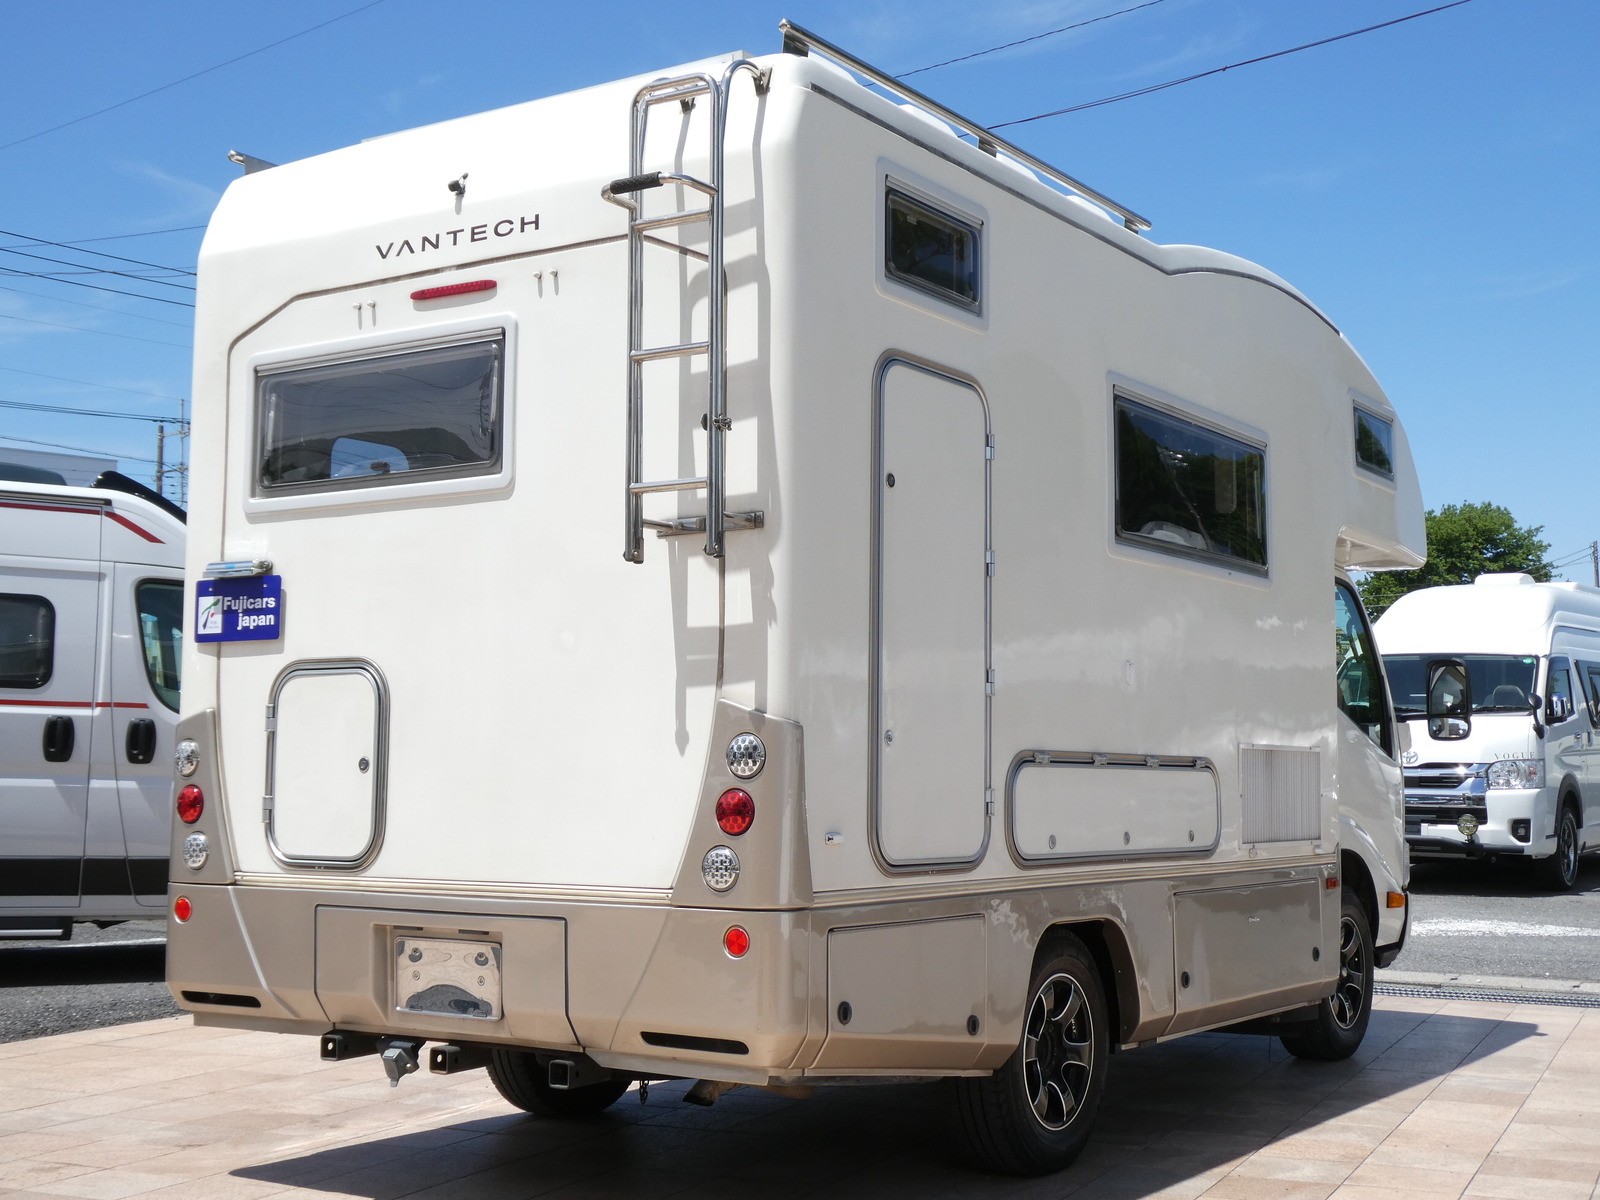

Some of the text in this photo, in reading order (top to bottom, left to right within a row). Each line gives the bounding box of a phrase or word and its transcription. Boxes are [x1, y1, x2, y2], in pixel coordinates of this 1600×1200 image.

[375, 213, 540, 260] VANTECH
[223, 595, 276, 613] Fujicars
[236, 612, 275, 631] japan
[1494, 751, 1535, 760] VOGUE
